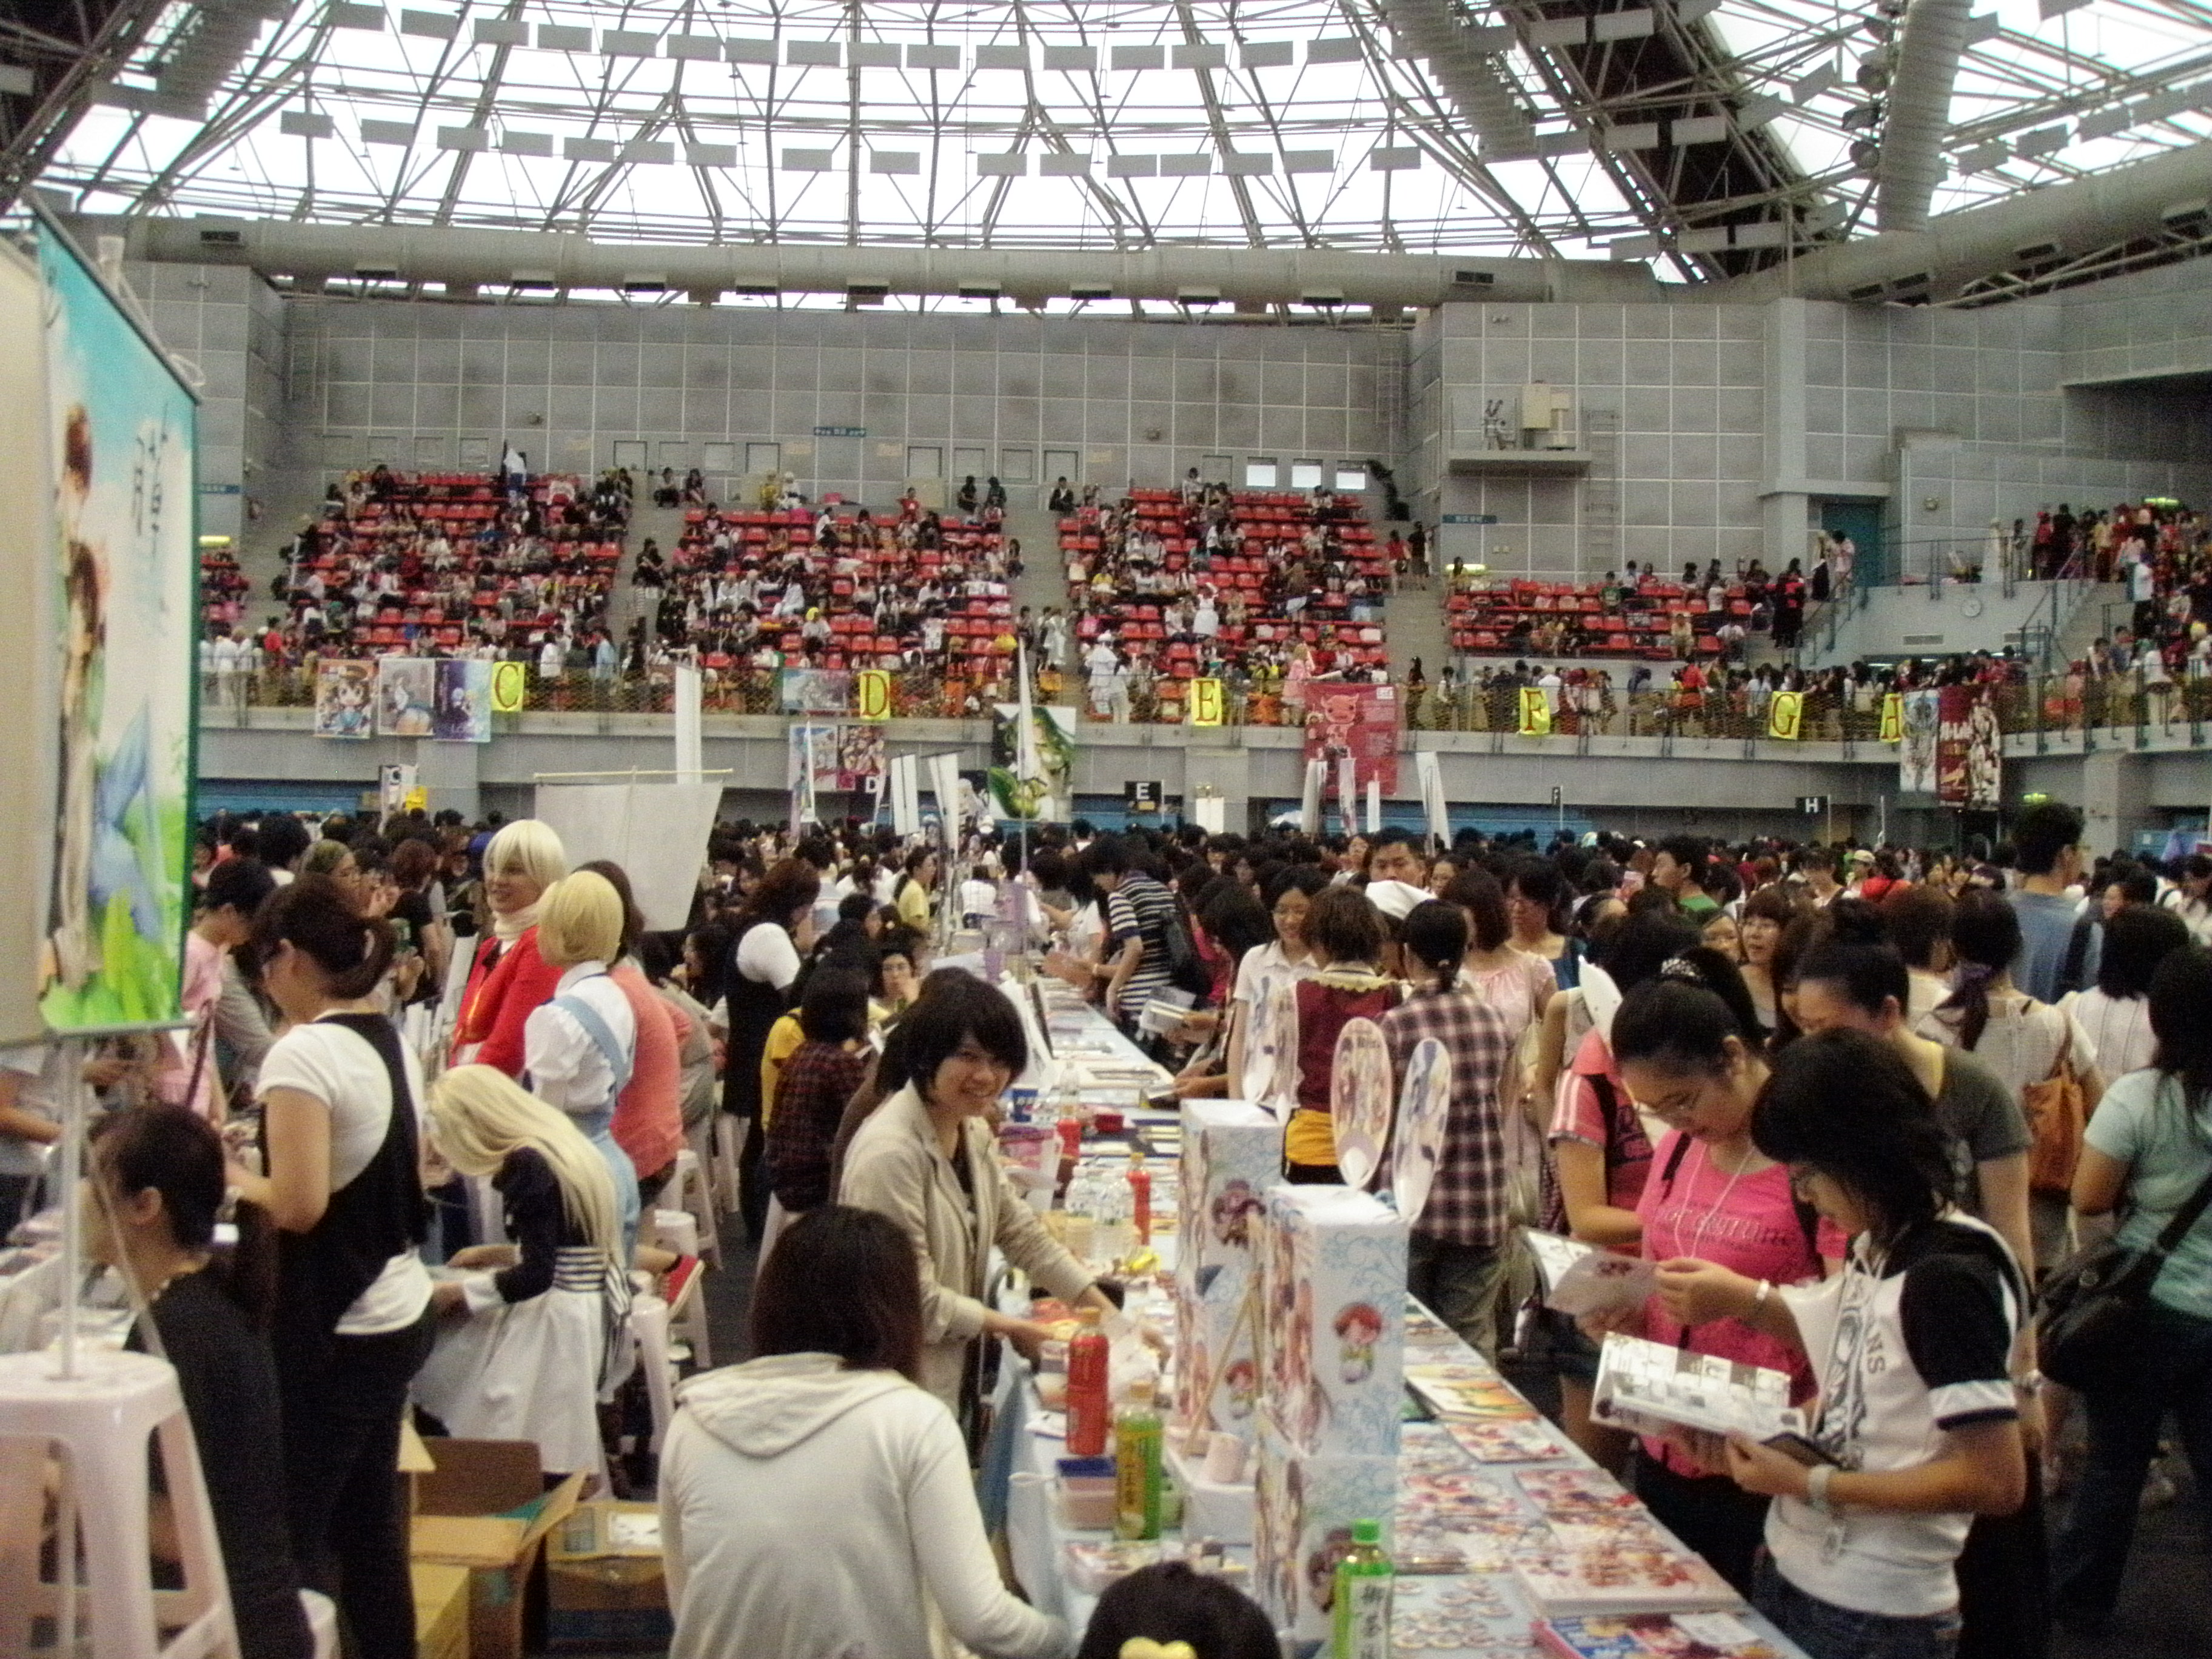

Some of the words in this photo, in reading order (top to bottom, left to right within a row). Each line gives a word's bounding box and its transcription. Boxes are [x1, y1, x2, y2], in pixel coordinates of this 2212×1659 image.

[495, 663, 518, 709] C
[863, 673, 888, 716] D
[1196, 680, 1217, 722] E
[1524, 689, 1543, 731] F
[1772, 693, 1797, 736] G
[1881, 697, 1901, 739] H
[865, 776, 879, 793] D
[1136, 782, 1150, 800] E
[1806, 797, 1818, 813] H
